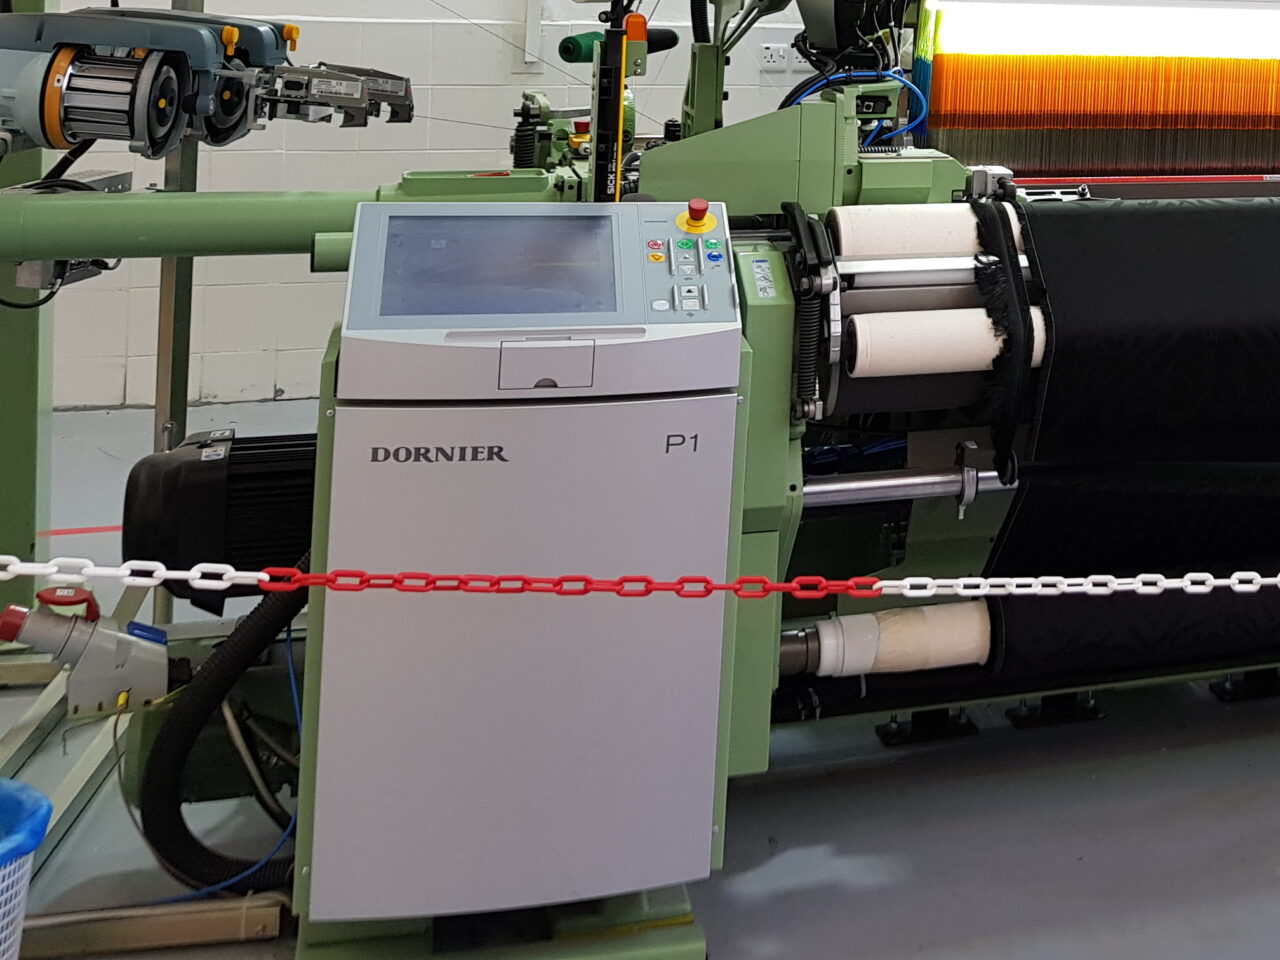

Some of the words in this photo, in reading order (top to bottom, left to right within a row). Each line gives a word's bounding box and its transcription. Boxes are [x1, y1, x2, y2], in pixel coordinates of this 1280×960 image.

[607, 172, 616, 195] SICK
[370, 445, 508, 462] DORNIER
[665, 434, 699, 454] P1
